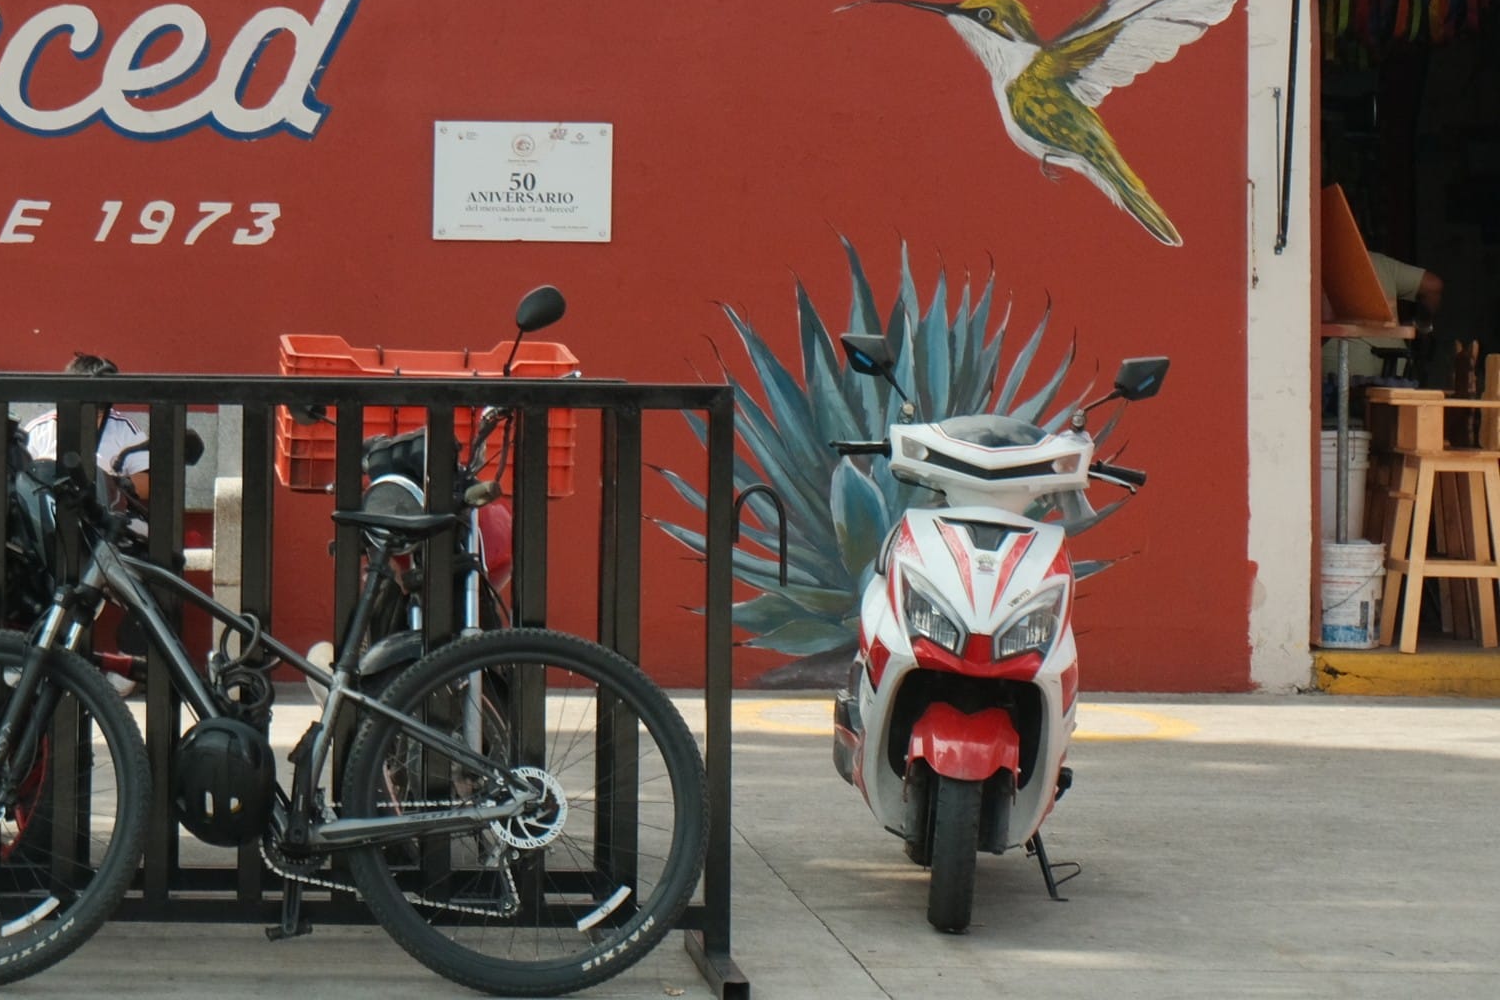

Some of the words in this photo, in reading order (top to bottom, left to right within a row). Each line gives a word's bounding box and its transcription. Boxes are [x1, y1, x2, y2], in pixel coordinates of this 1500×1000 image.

[467, 191, 574, 204] ANIVERSARIO
[509, 172, 536, 191] 50
[95, 200, 281, 246] 1973
[0, 917, 75, 966] MAXXIS
[581, 915, 656, 972] MAXXIS
